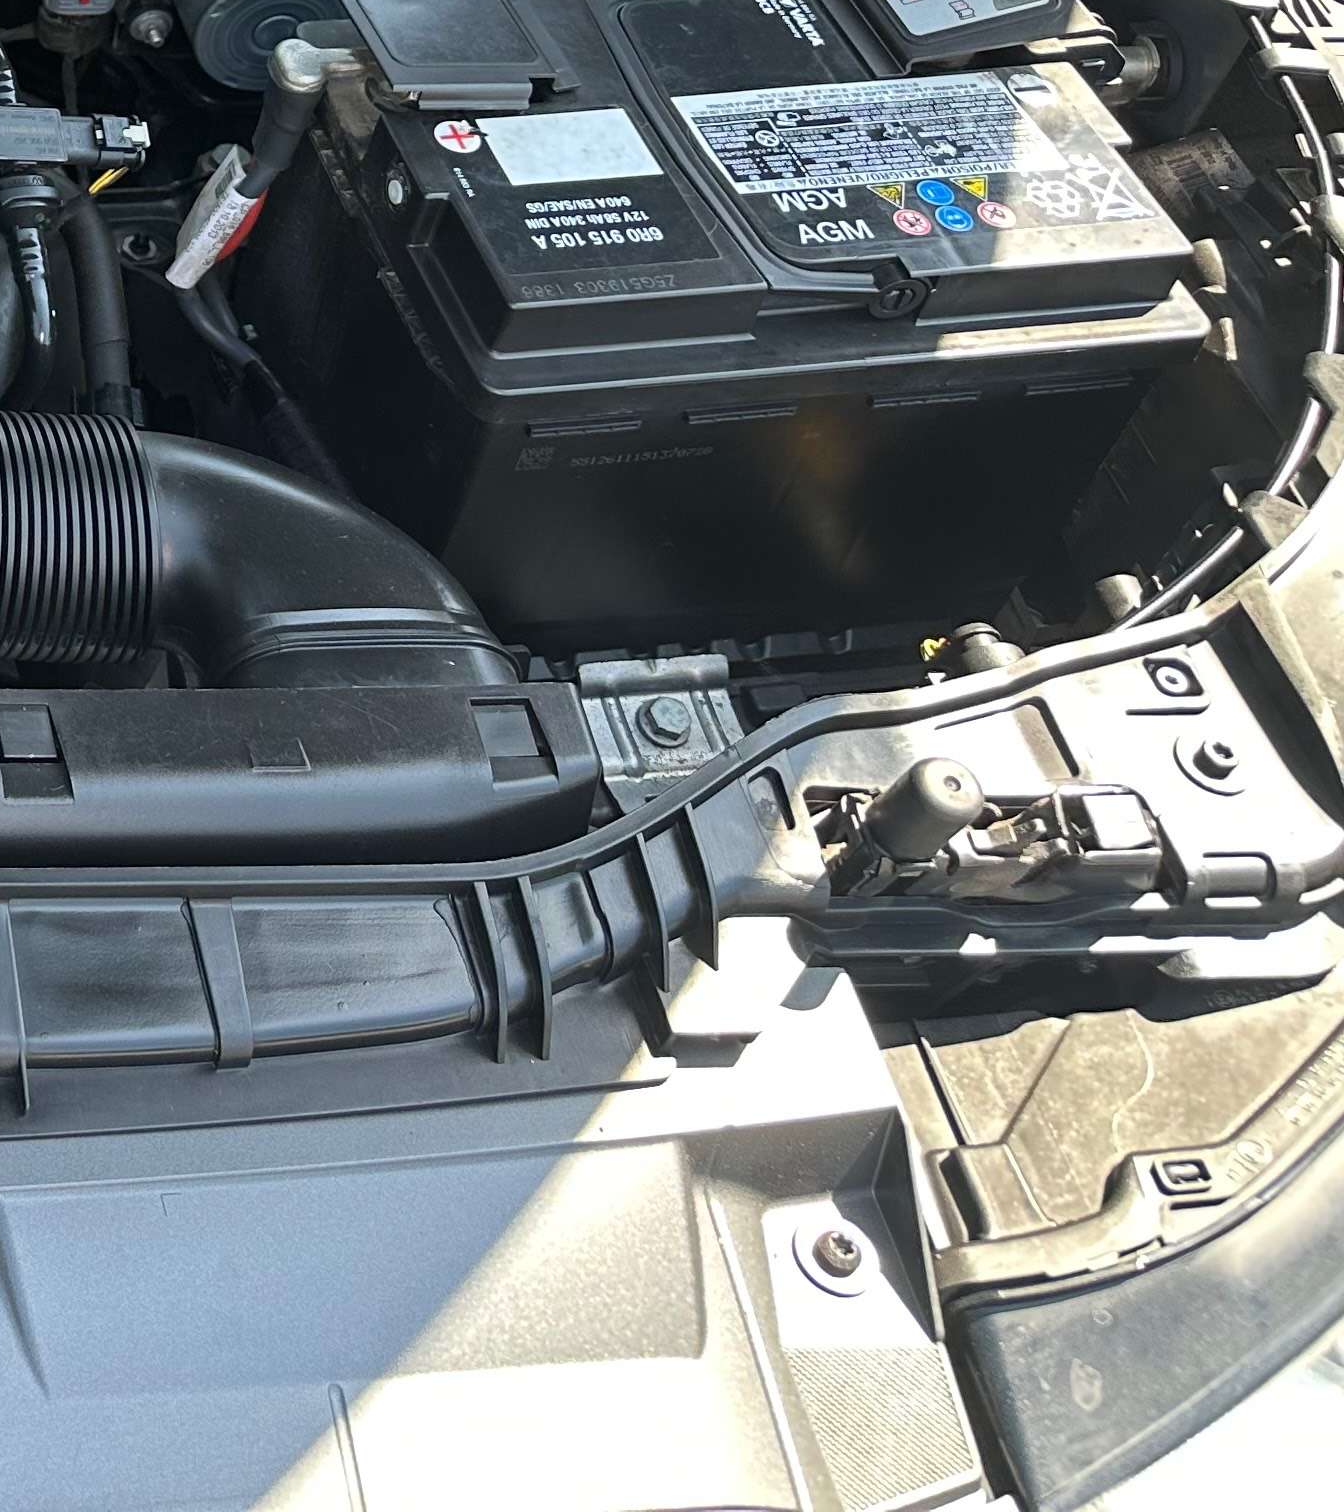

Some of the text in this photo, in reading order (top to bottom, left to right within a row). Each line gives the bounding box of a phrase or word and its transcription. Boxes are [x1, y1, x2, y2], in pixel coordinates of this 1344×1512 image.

[786, 7, 826, 46] VARTA
[809, 168, 929, 188] PELIGRO/VENENO
[525, 195, 632, 213] 640A EN/SAE/GS
[772, 188, 847, 213] AGM
[525, 210, 650, 230] 12V 58Ah 340A DIN
[797, 218, 875, 245] AGM
[531, 226, 664, 250] 6R0 915 105 A
